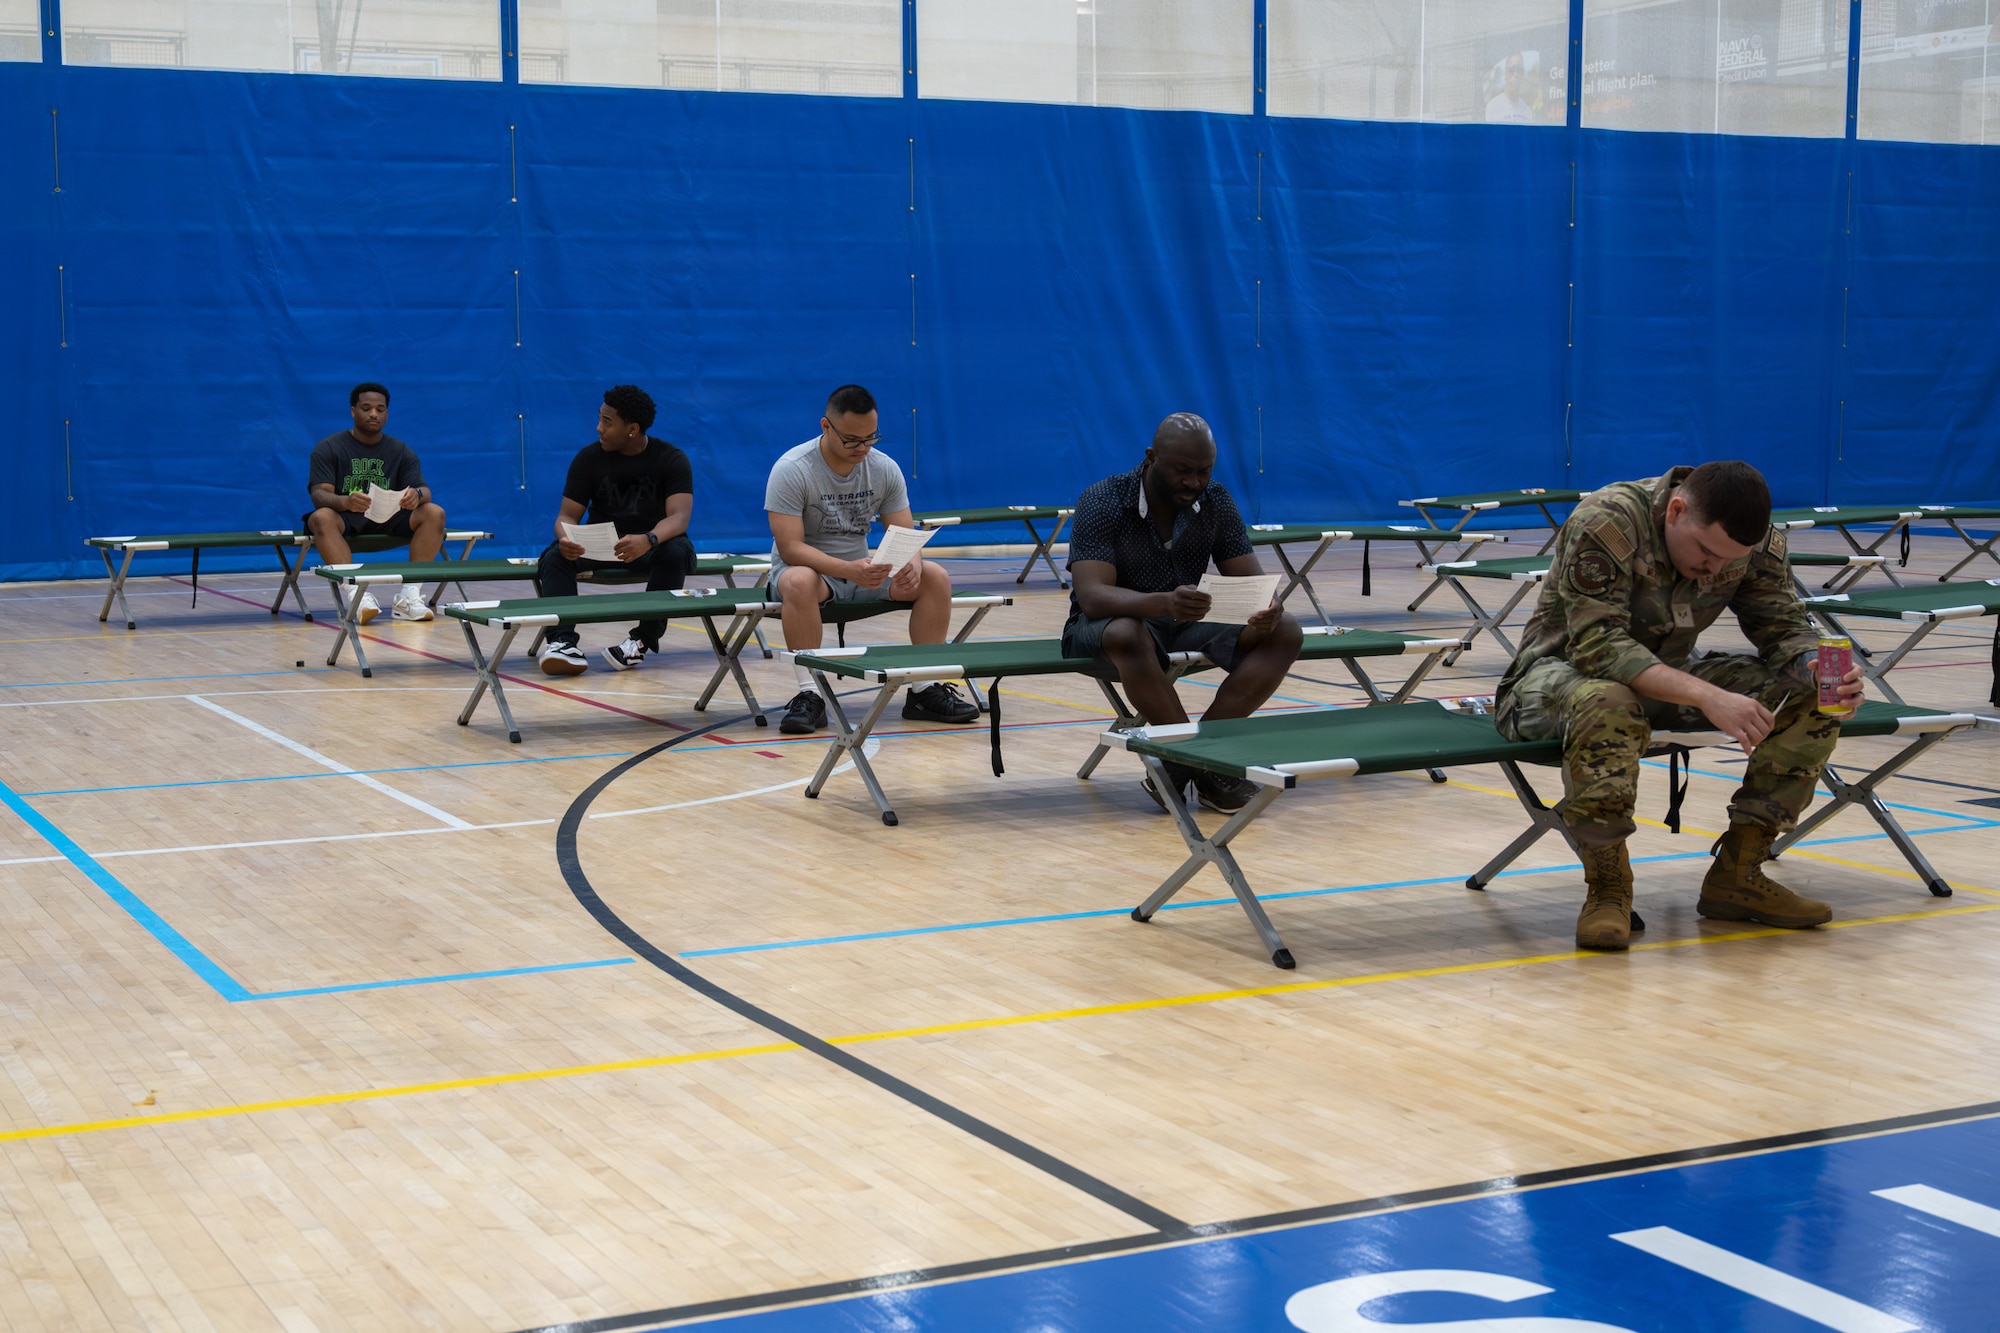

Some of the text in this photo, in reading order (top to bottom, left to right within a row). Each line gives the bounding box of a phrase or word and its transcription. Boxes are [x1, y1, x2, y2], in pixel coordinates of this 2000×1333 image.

[1719, 38, 1750, 54] NAVY
[1719, 48, 1767, 67] FEDERAL
[1549, 66, 1565, 80] Ge
[1718, 68, 1767, 83] Credit Union
[1597, 76, 1627, 94] flight
[1629, 72, 1657, 90] plan.
[351, 457, 385, 477] ROCK
[838, 489, 874, 500] STRAUSS
[1713, 573, 1725, 584] AIR
[1725, 566, 1746, 581] FORCE
